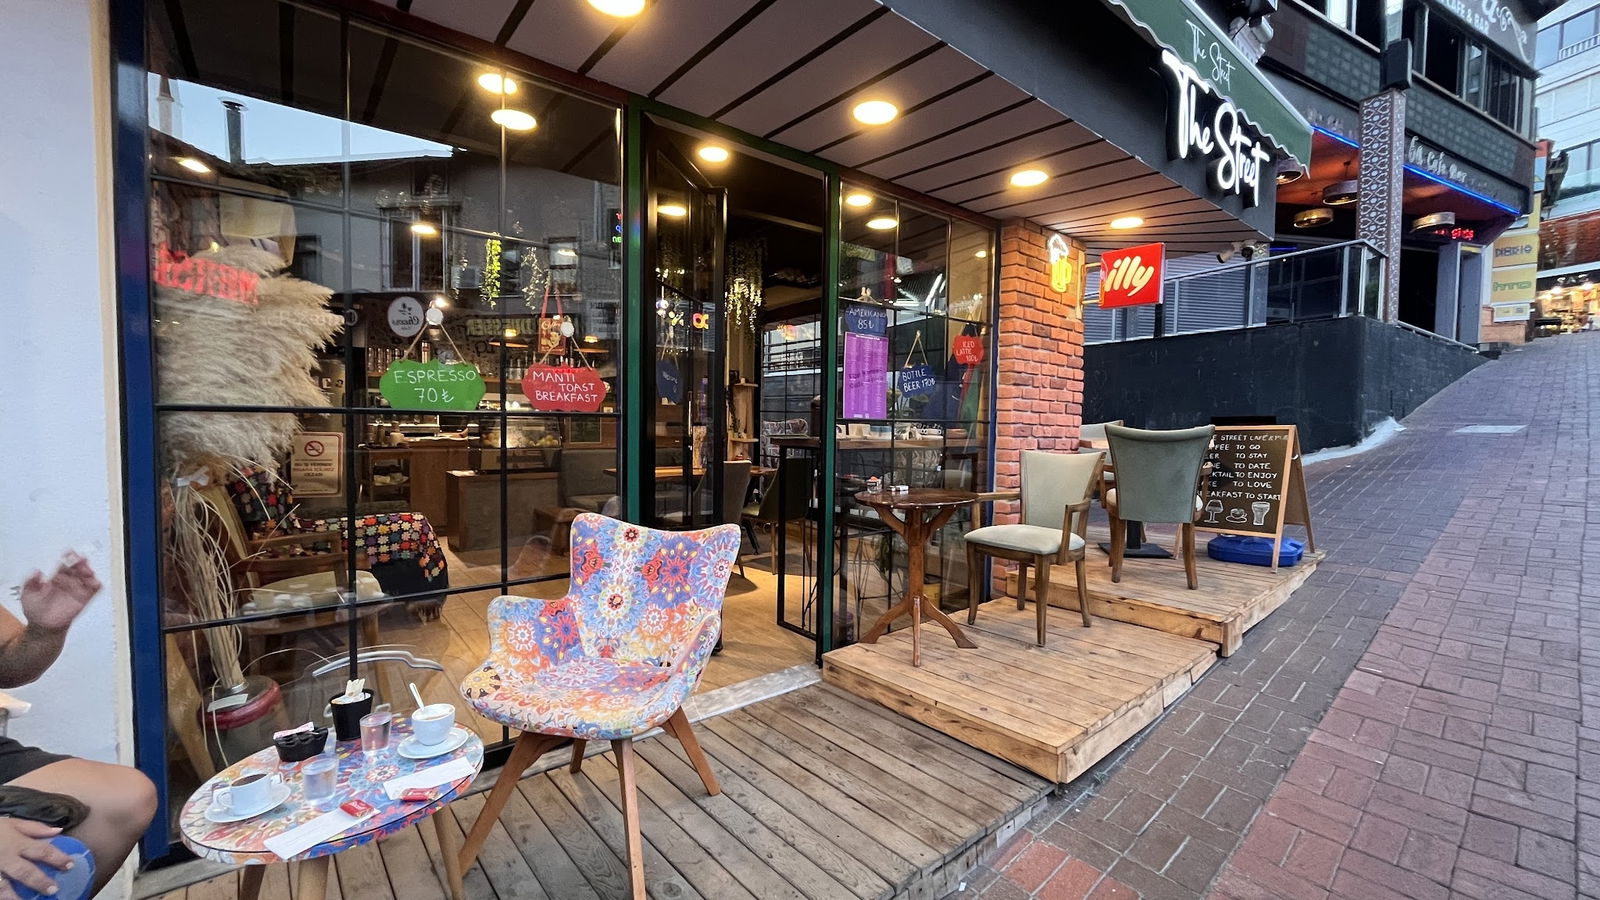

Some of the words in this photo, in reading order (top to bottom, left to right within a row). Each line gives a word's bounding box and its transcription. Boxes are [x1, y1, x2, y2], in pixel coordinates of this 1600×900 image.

[1474, 13, 1490, 35] BAR
[1186, 19, 1207, 63] The
[1209, 42, 1236, 91] Street
[1162, 49, 1214, 159] The
[1214, 102, 1270, 207] Street
[1104, 255, 1155, 297] illy
[393, 369, 477, 384] ESPRESSO
[533, 371, 575, 383] MANTI
[902, 368, 927, 381] BOTTLE
[558, 383, 595, 393] TOAST
[903, 380, 921, 393] BEER
[535, 390, 598, 403] BREAKFAST
[1248, 462, 1271, 470] DATE
[1247, 471, 1278, 479] ENJOY
